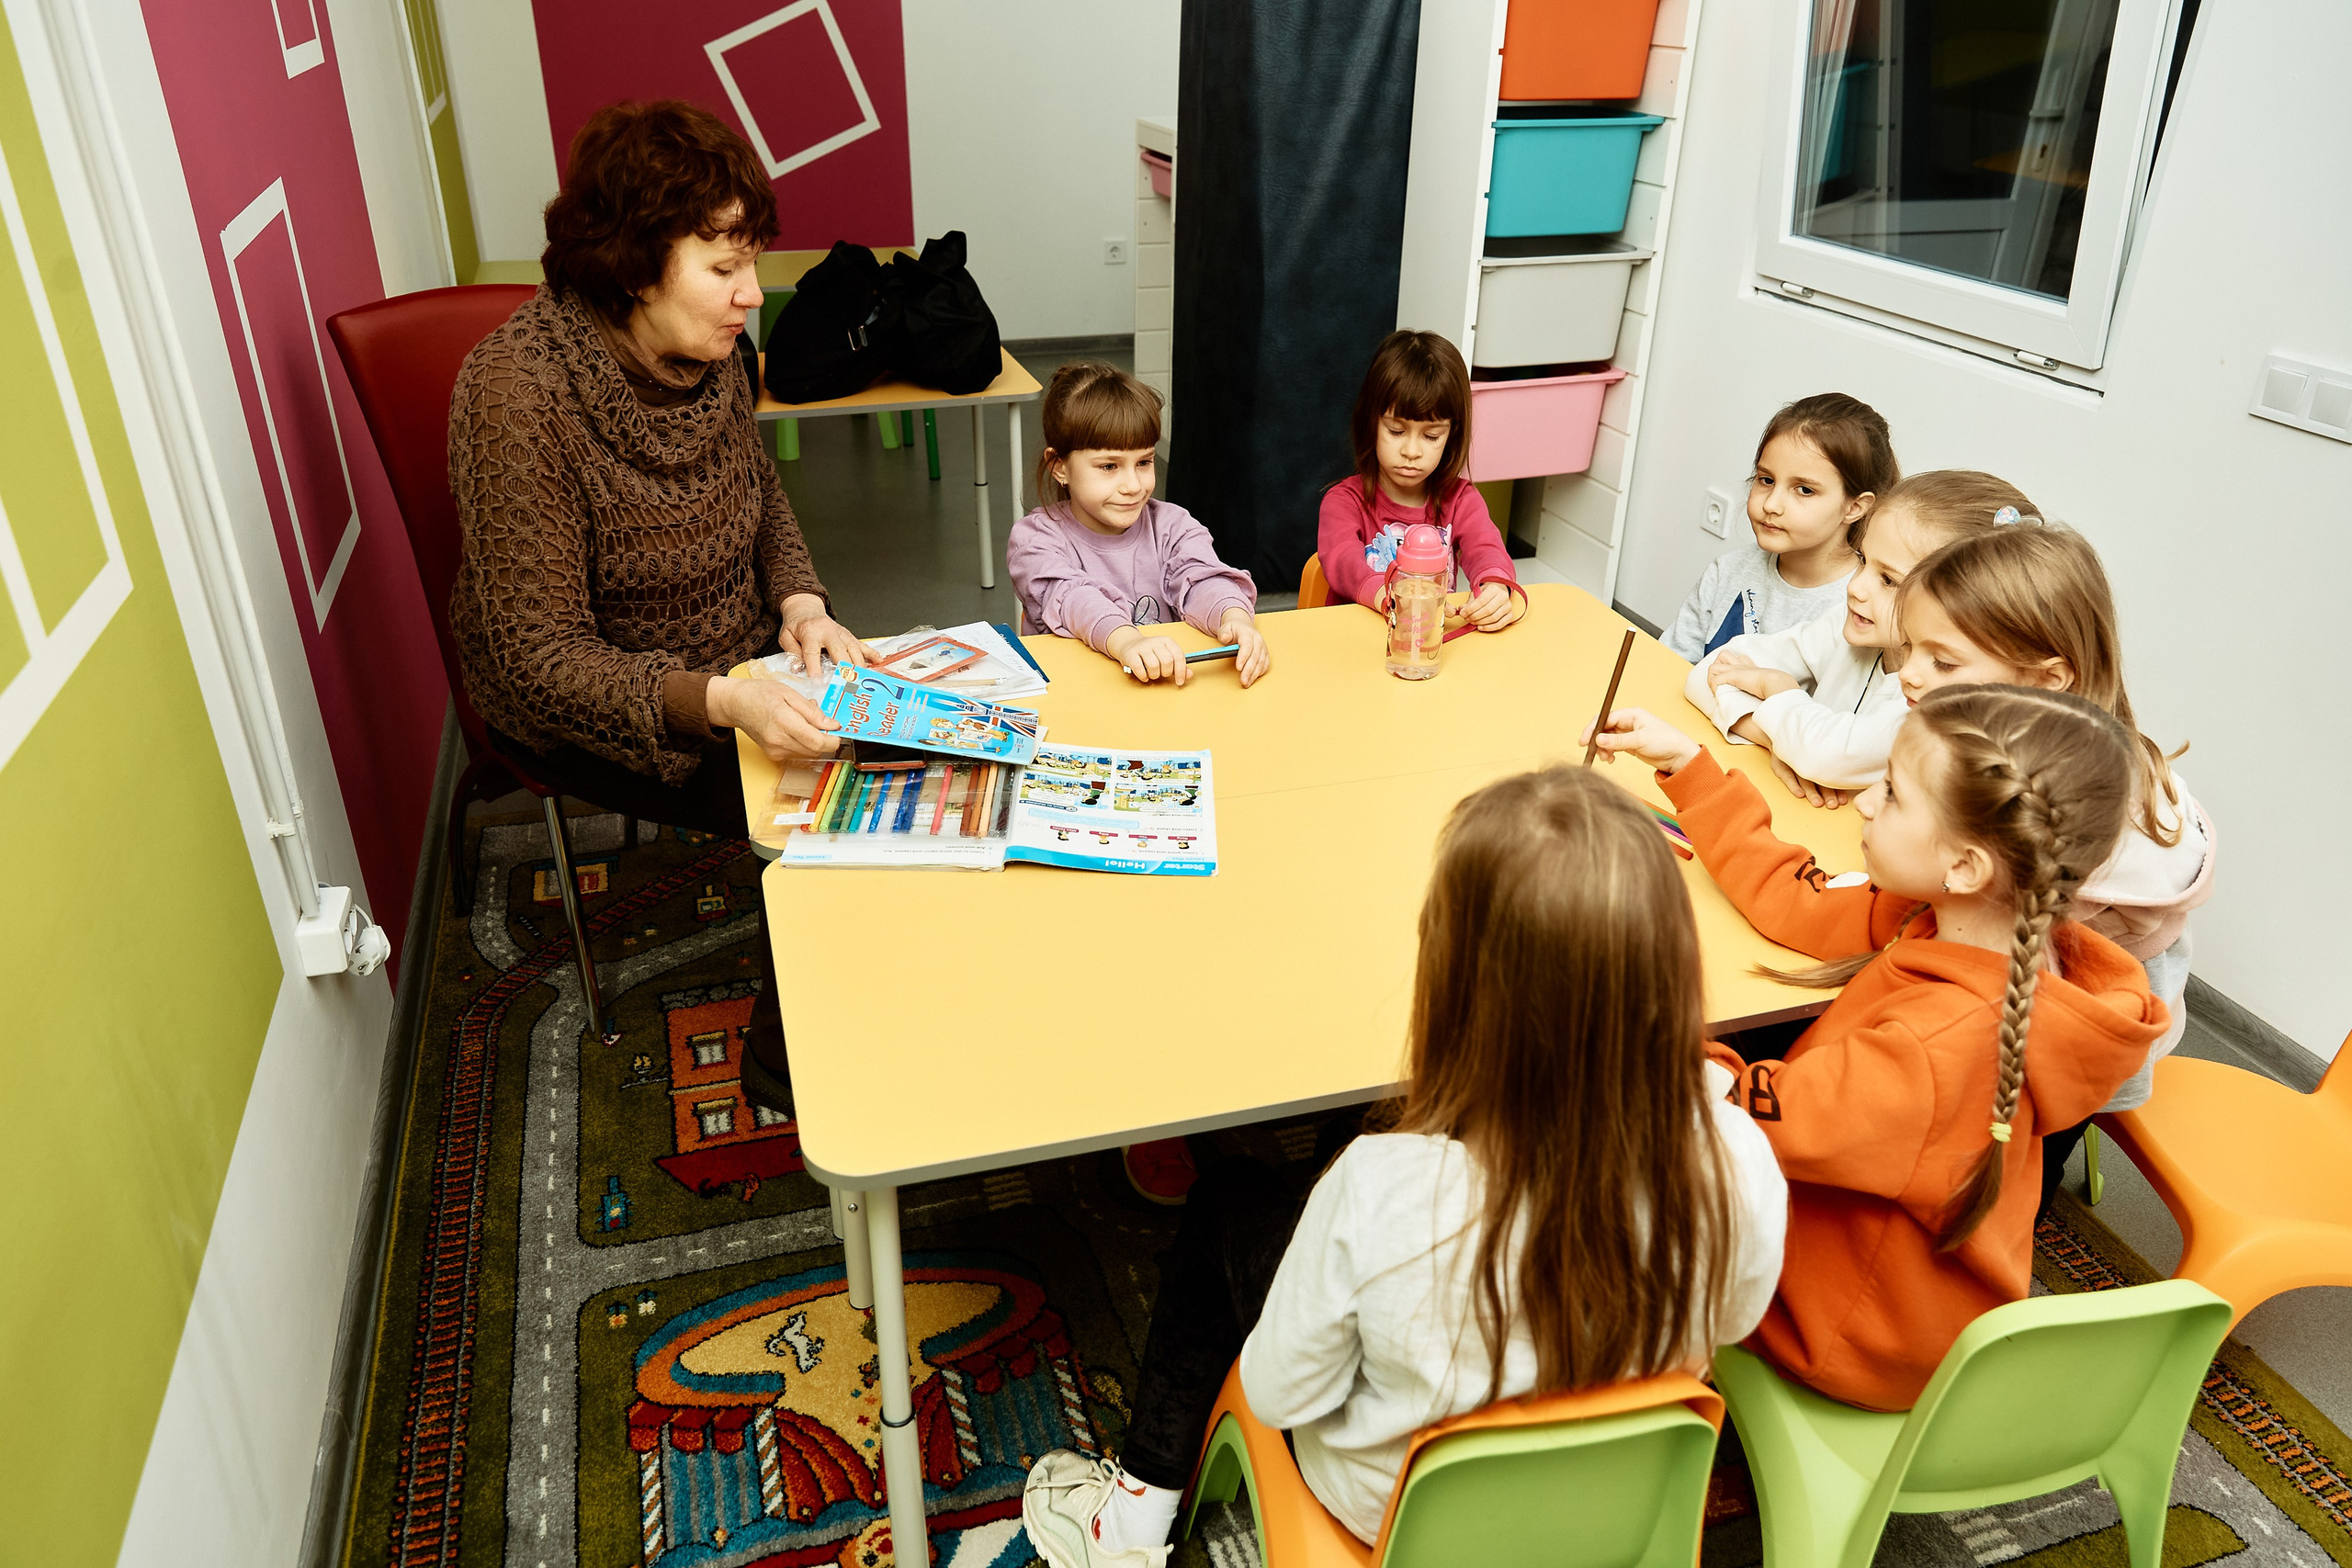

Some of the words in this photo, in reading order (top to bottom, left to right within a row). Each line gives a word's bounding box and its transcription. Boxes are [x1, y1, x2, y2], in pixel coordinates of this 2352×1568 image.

[1745, 588, 1756, 617] shining
[839, 694, 872, 734] English
[861, 678, 905, 700] 2
[866, 701, 900, 737] Reader
[1104, 860, 1147, 870] Hello!
[1163, 863, 1205, 871] Starter
